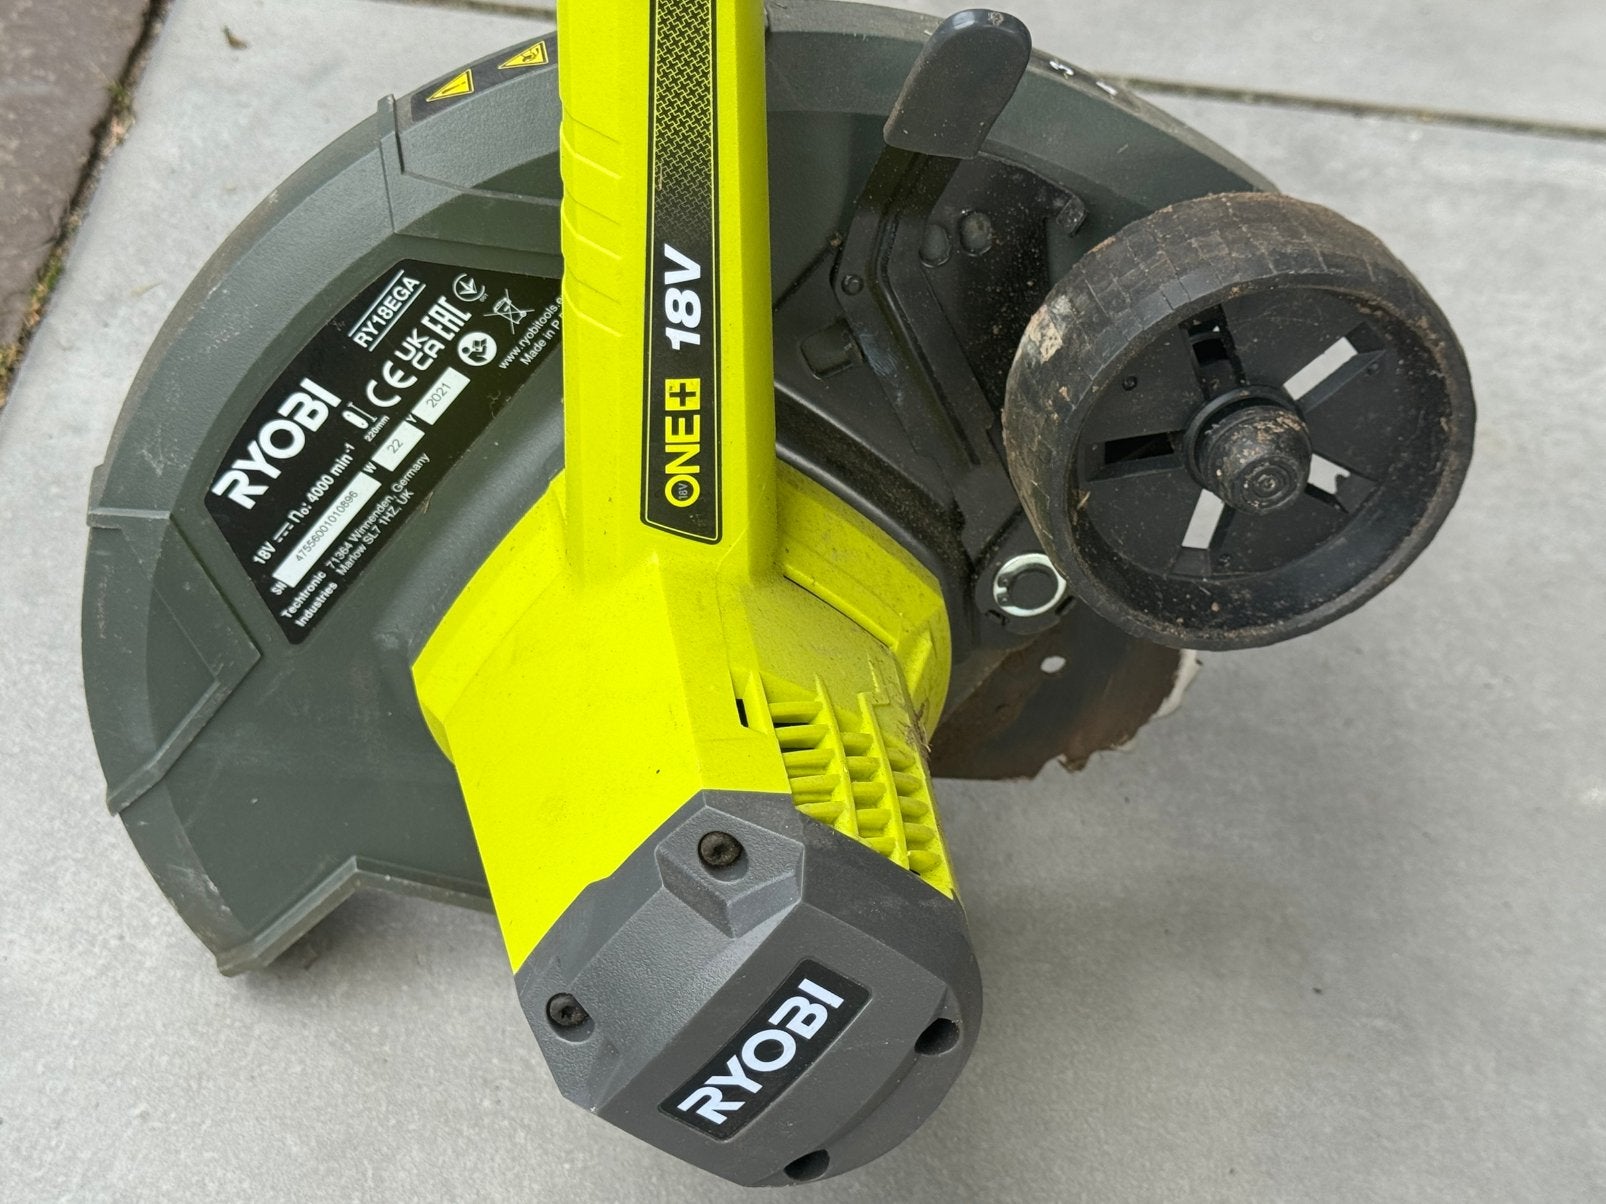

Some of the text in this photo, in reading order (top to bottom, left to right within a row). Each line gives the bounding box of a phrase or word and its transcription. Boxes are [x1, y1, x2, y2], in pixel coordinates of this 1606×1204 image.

[353, 277, 420, 348] RY18EGA
[664, 243, 702, 351] 18V
[520, 339, 547, 366] Made
[542, 329, 556, 340] in
[364, 415, 390, 442] 220mm
[366, 360, 418, 418] CE
[211, 377, 342, 510] RYOBI
[295, 490, 359, 562] 47556001010896
[363, 461, 377, 474] W
[386, 438, 404, 454] 22
[405, 414, 417, 423] Y
[425, 382, 452, 409] 2021
[253, 541, 276, 564] 18V
[306, 474, 335, 503] 4000
[325, 453, 430, 569] 71364 Winnenden, Germany
[678, 482, 688, 500] 18V
[335, 488, 415, 576] Marlow SL7 1HZ, UK
[281, 571, 327, 618] Techtronic
[295, 582, 338, 627] Industries
[677, 977, 844, 1125] RYOBI
